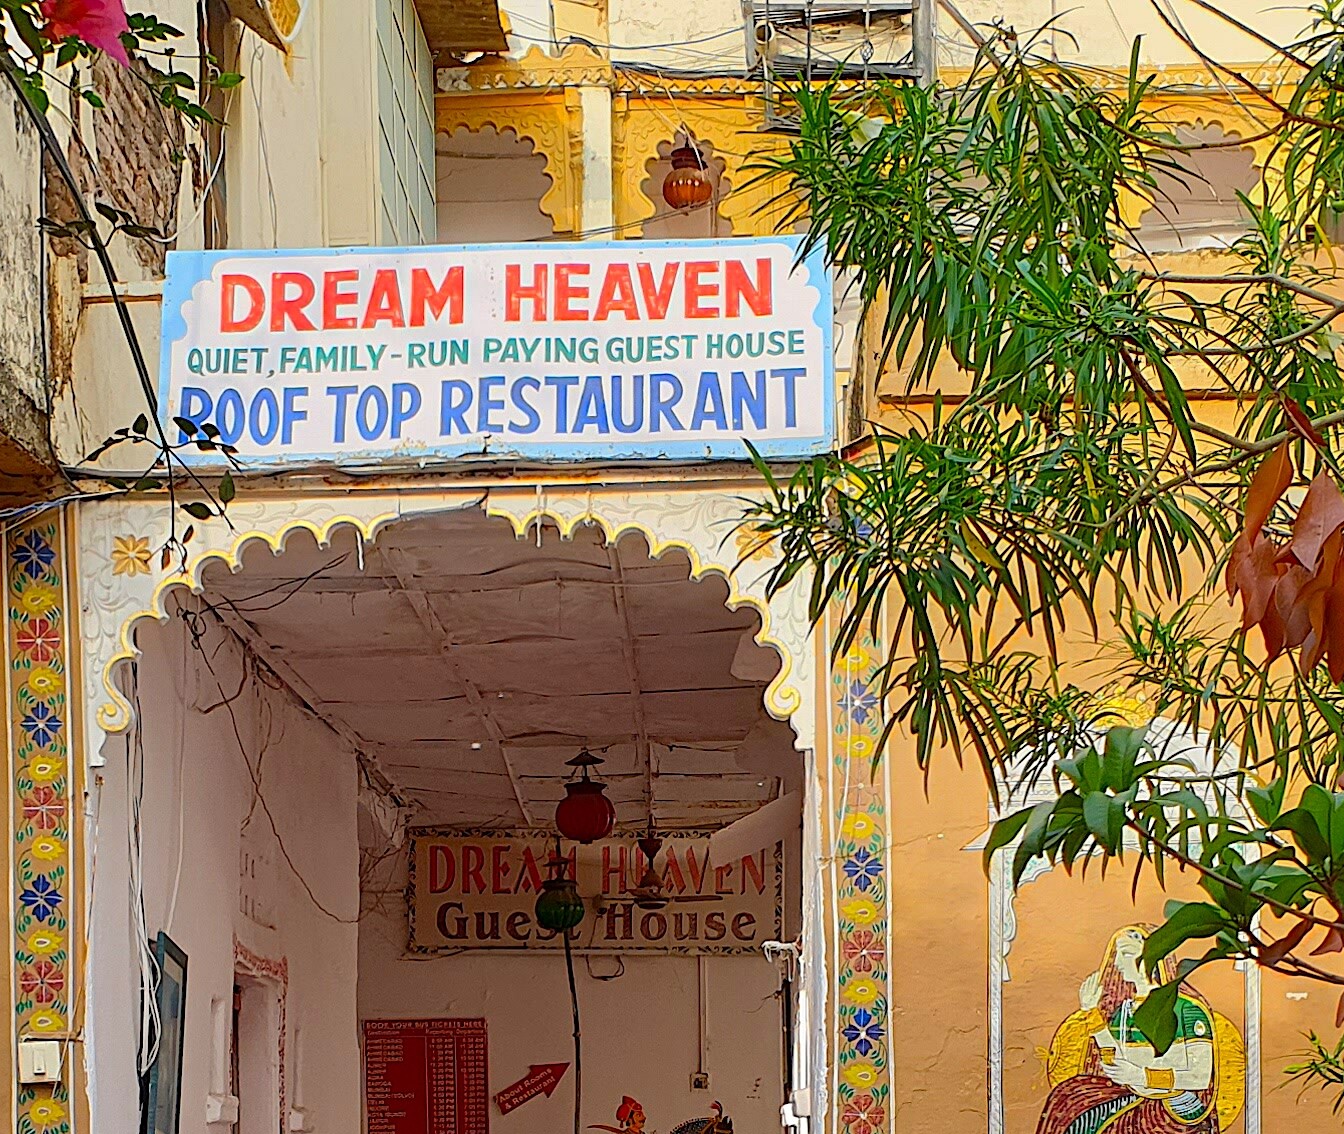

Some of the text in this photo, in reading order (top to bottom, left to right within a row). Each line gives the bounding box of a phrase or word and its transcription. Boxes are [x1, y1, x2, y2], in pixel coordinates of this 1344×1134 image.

[220, 257, 773, 334] DREAM HEAVEN
[482, 336, 600, 365] PAYING
[605, 334, 699, 364] GUEST
[706, 329, 805, 360] HOUSE
[177, 367, 807, 447] ROOF TOP RESTAURANT
[605, 902, 757, 941] House
[499, 1068, 552, 1103] About Rooms
[504, 1075, 556, 1110] & Restaurant
